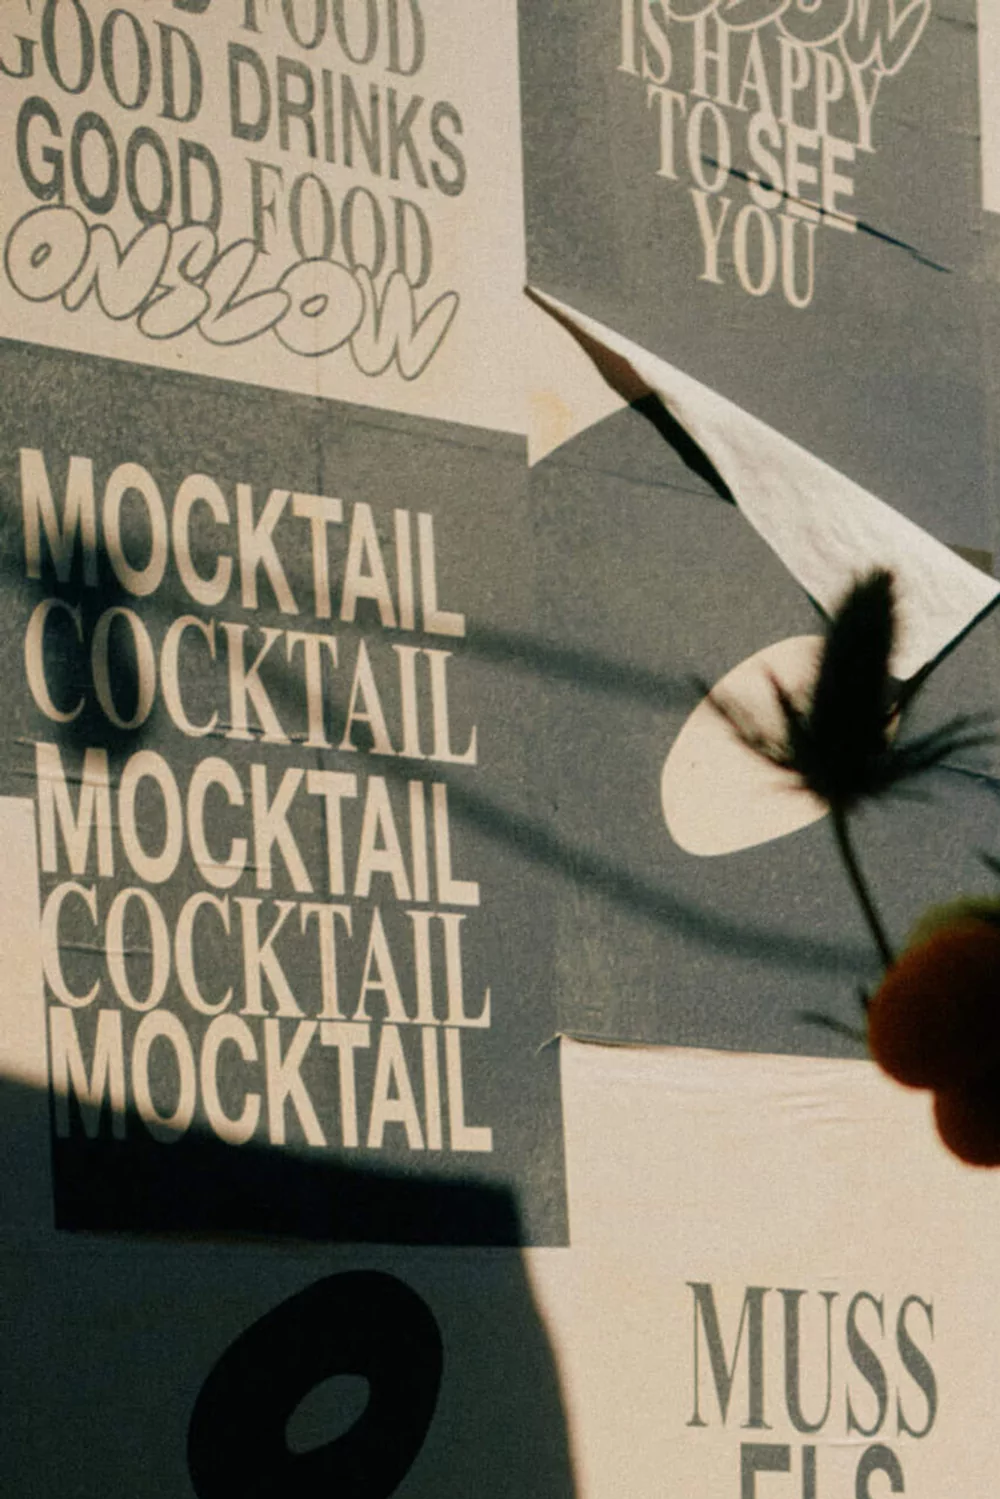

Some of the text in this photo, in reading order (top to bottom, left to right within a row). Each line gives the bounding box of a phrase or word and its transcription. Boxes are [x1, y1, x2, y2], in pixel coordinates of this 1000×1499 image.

[227, 41, 468, 197] DRINKS
[617, 0, 672, 84] IS
[689, 10, 877, 153] HAPPY
[16, 96, 432, 290] GOOD FOOD
[646, 83, 858, 233] TO SEE
[4, 203, 460, 381] ONSLOW
[689, 188, 818, 308] YOU
[19, 447, 467, 638] MOCKTAIL
[24, 598, 478, 766] COCKTAIL
[34, 741, 482, 906] MOCKTAIL
[40, 881, 492, 1030] COCKTAIL
[48, 1005, 494, 1153] MOCKTAIL
[685, 1281, 939, 1438] MUSS
